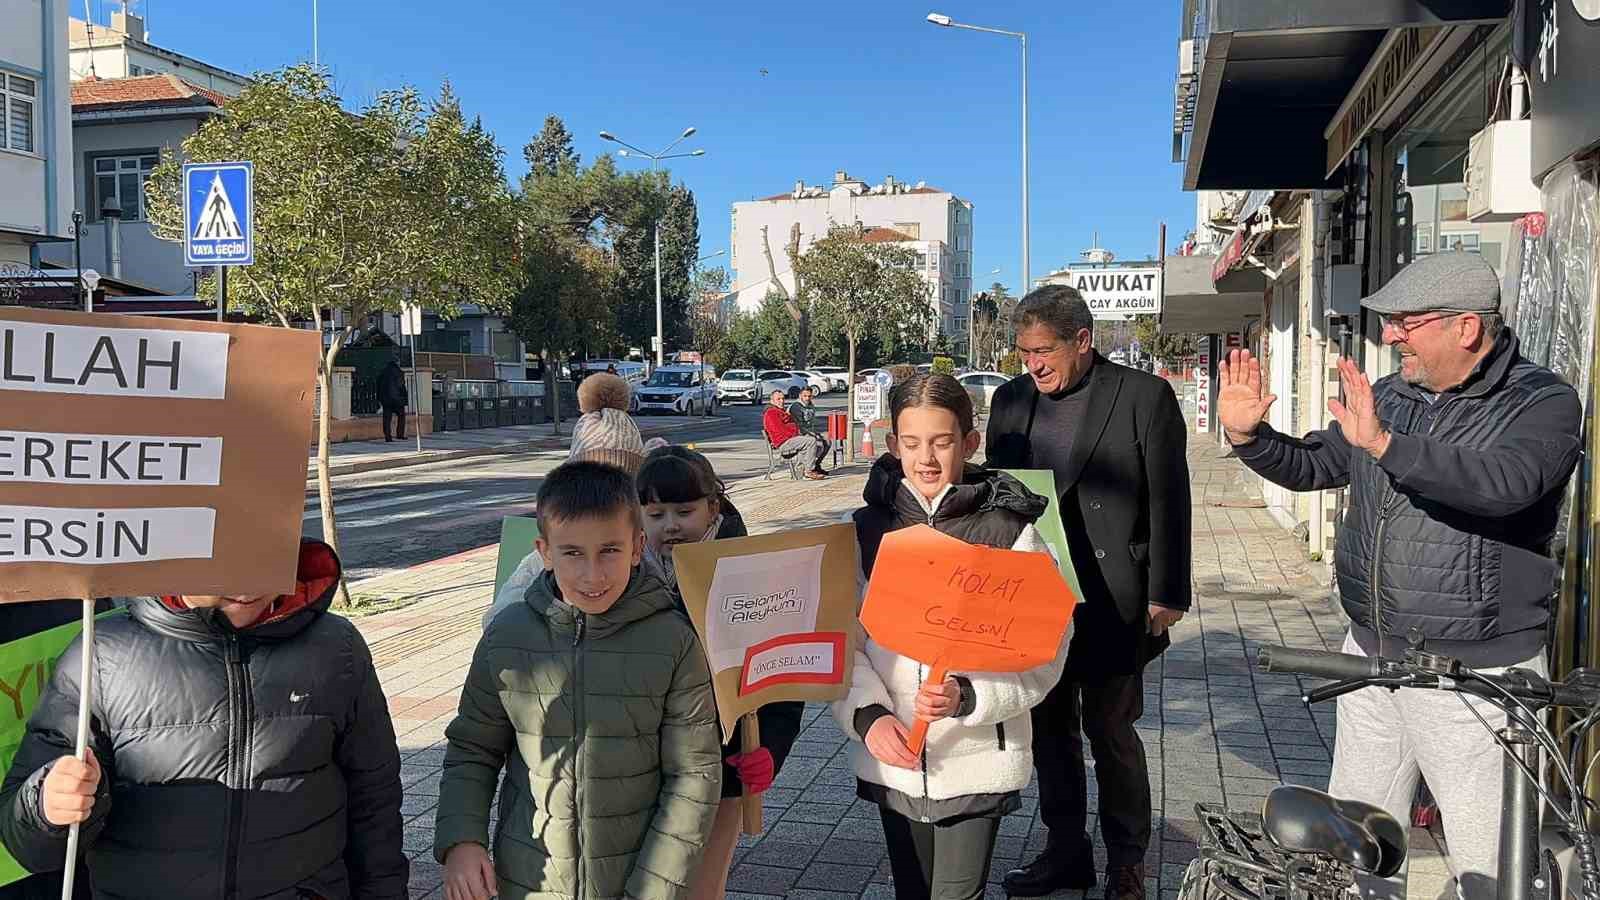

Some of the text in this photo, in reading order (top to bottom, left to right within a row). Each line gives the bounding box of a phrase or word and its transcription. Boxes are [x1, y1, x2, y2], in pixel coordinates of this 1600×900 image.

[192, 240, 245, 257] YAYA GEÇİDİ
[1077, 274, 1155, 292] AVUKAT
[1115, 295, 1155, 308] AKGÜN
[4, 329, 182, 390] LLAH
[732, 588, 796, 611] Selamun
